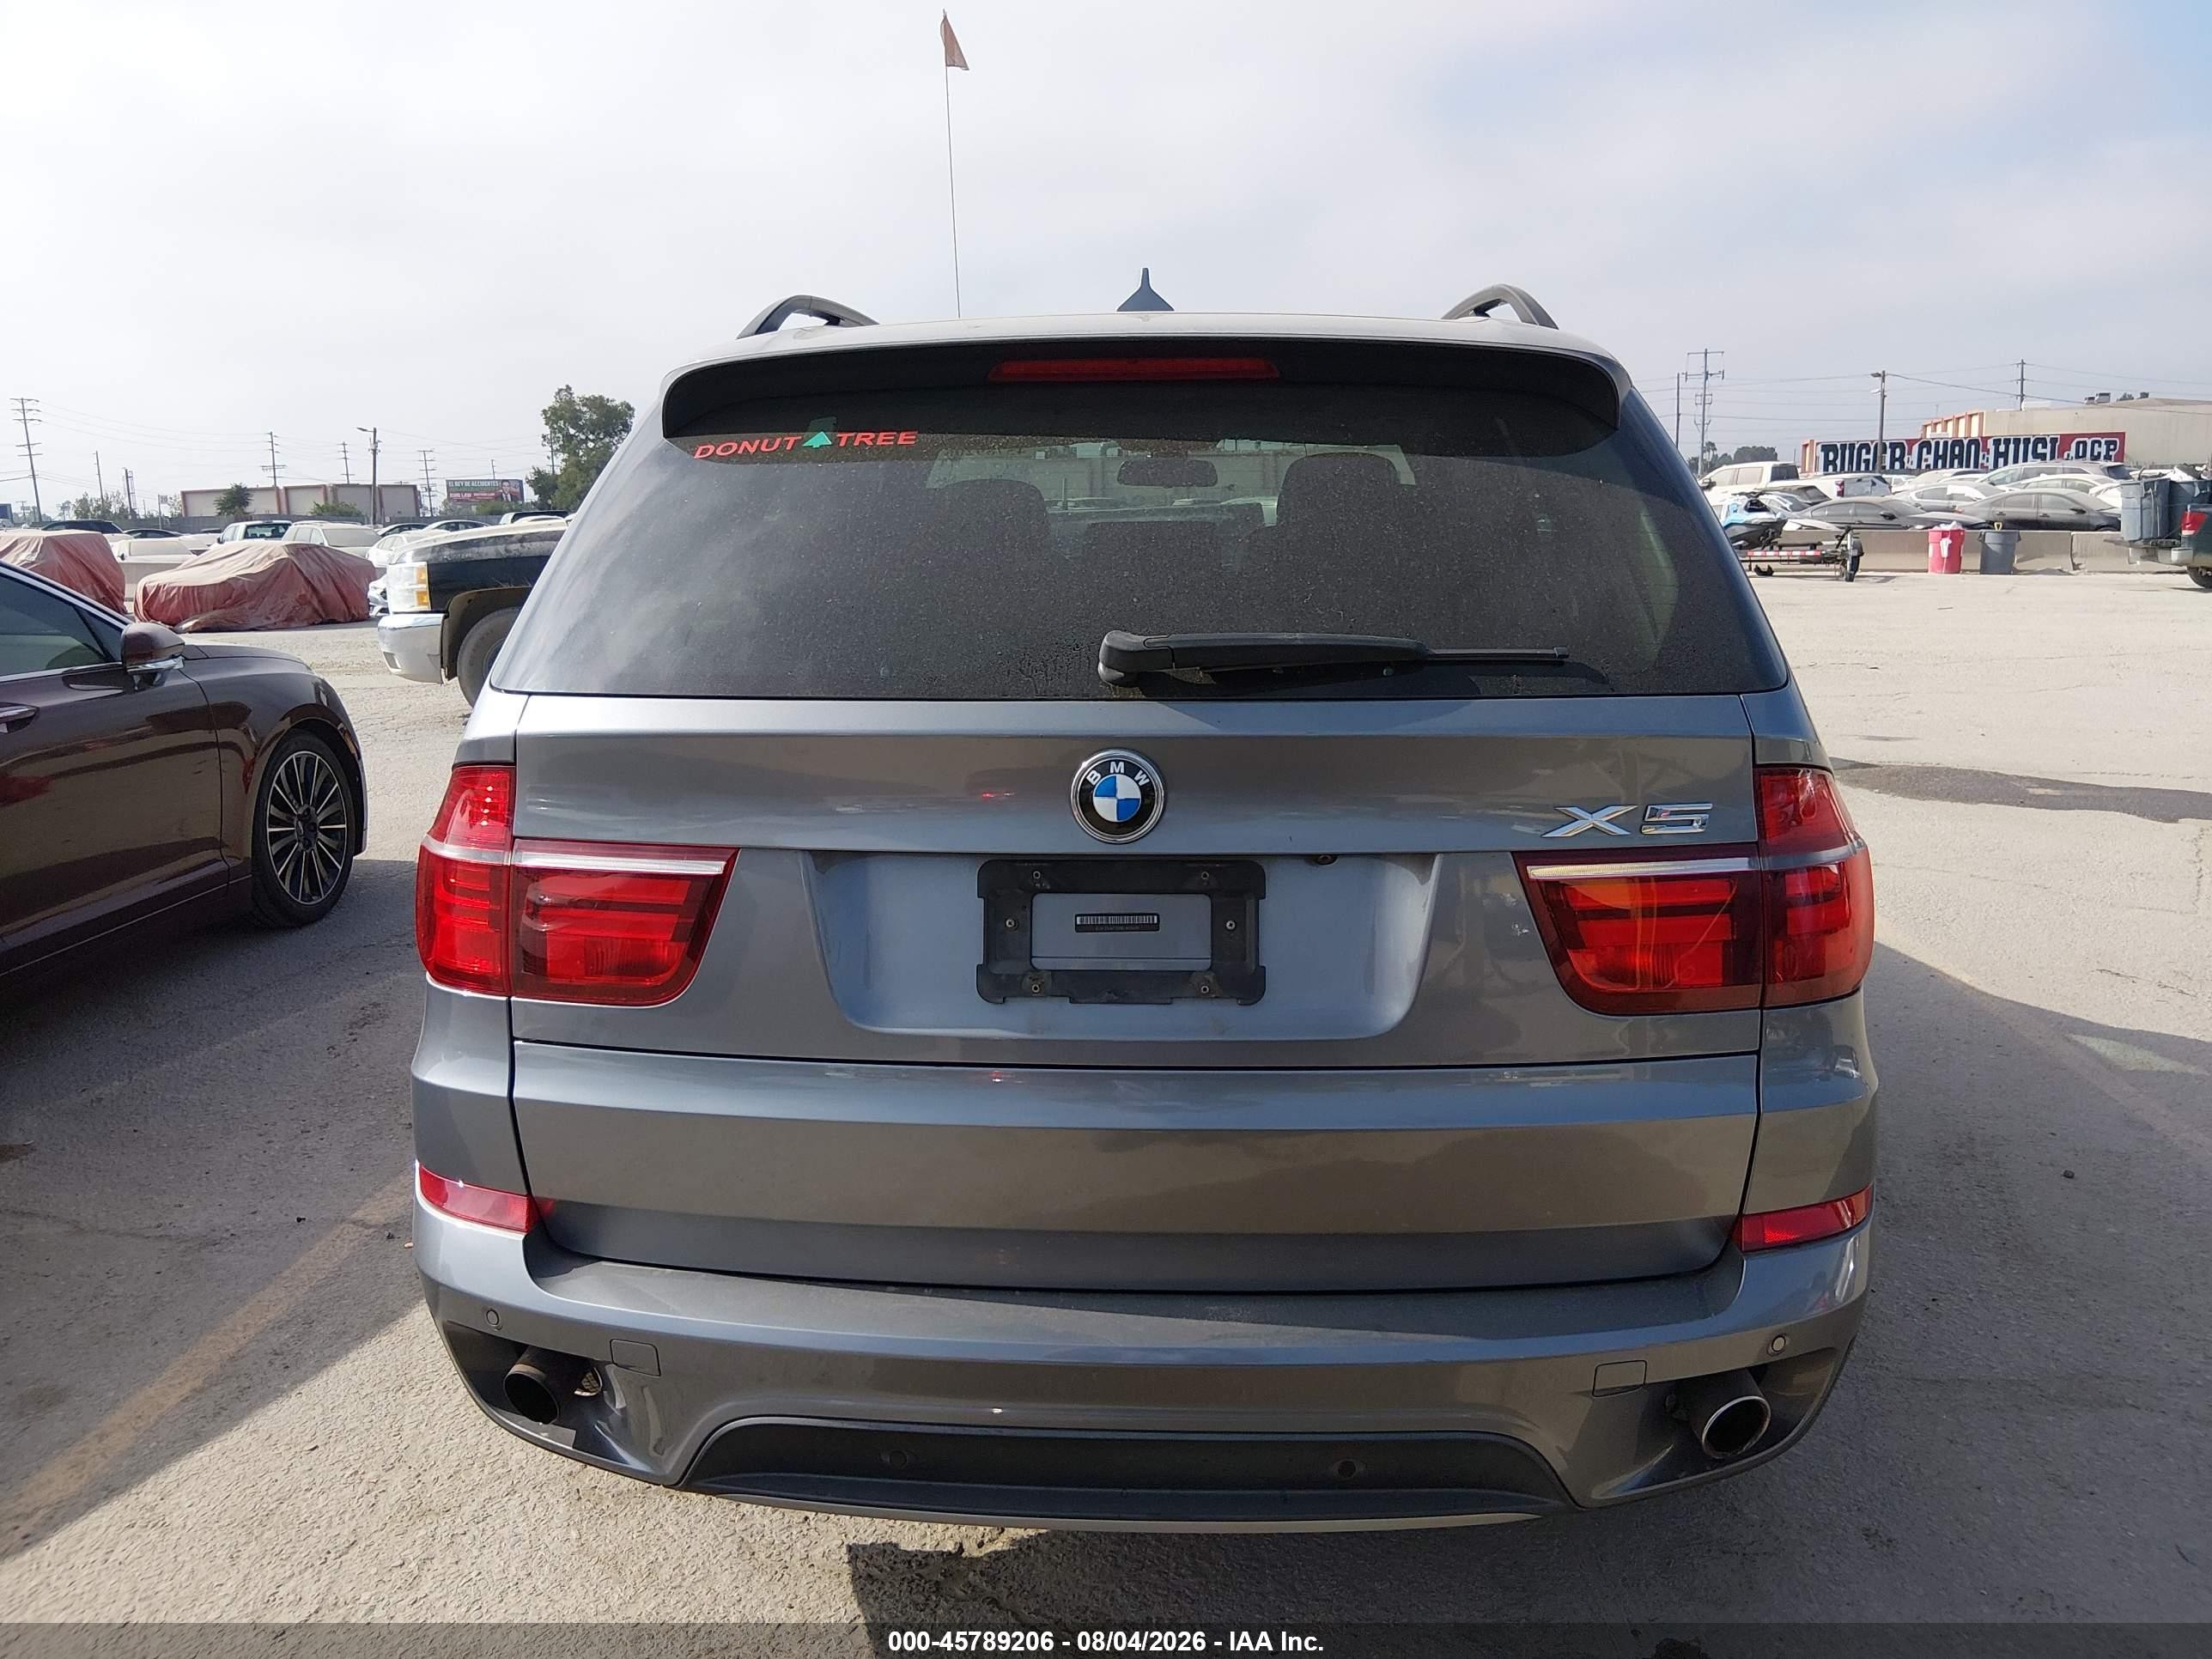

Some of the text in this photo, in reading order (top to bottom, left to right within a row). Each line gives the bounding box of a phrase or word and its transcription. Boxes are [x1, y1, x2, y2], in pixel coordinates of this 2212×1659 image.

[693, 431, 918, 459] DONUT TREE
[1085, 761, 1151, 787] BMW
[1541, 803, 1713, 838] X5
